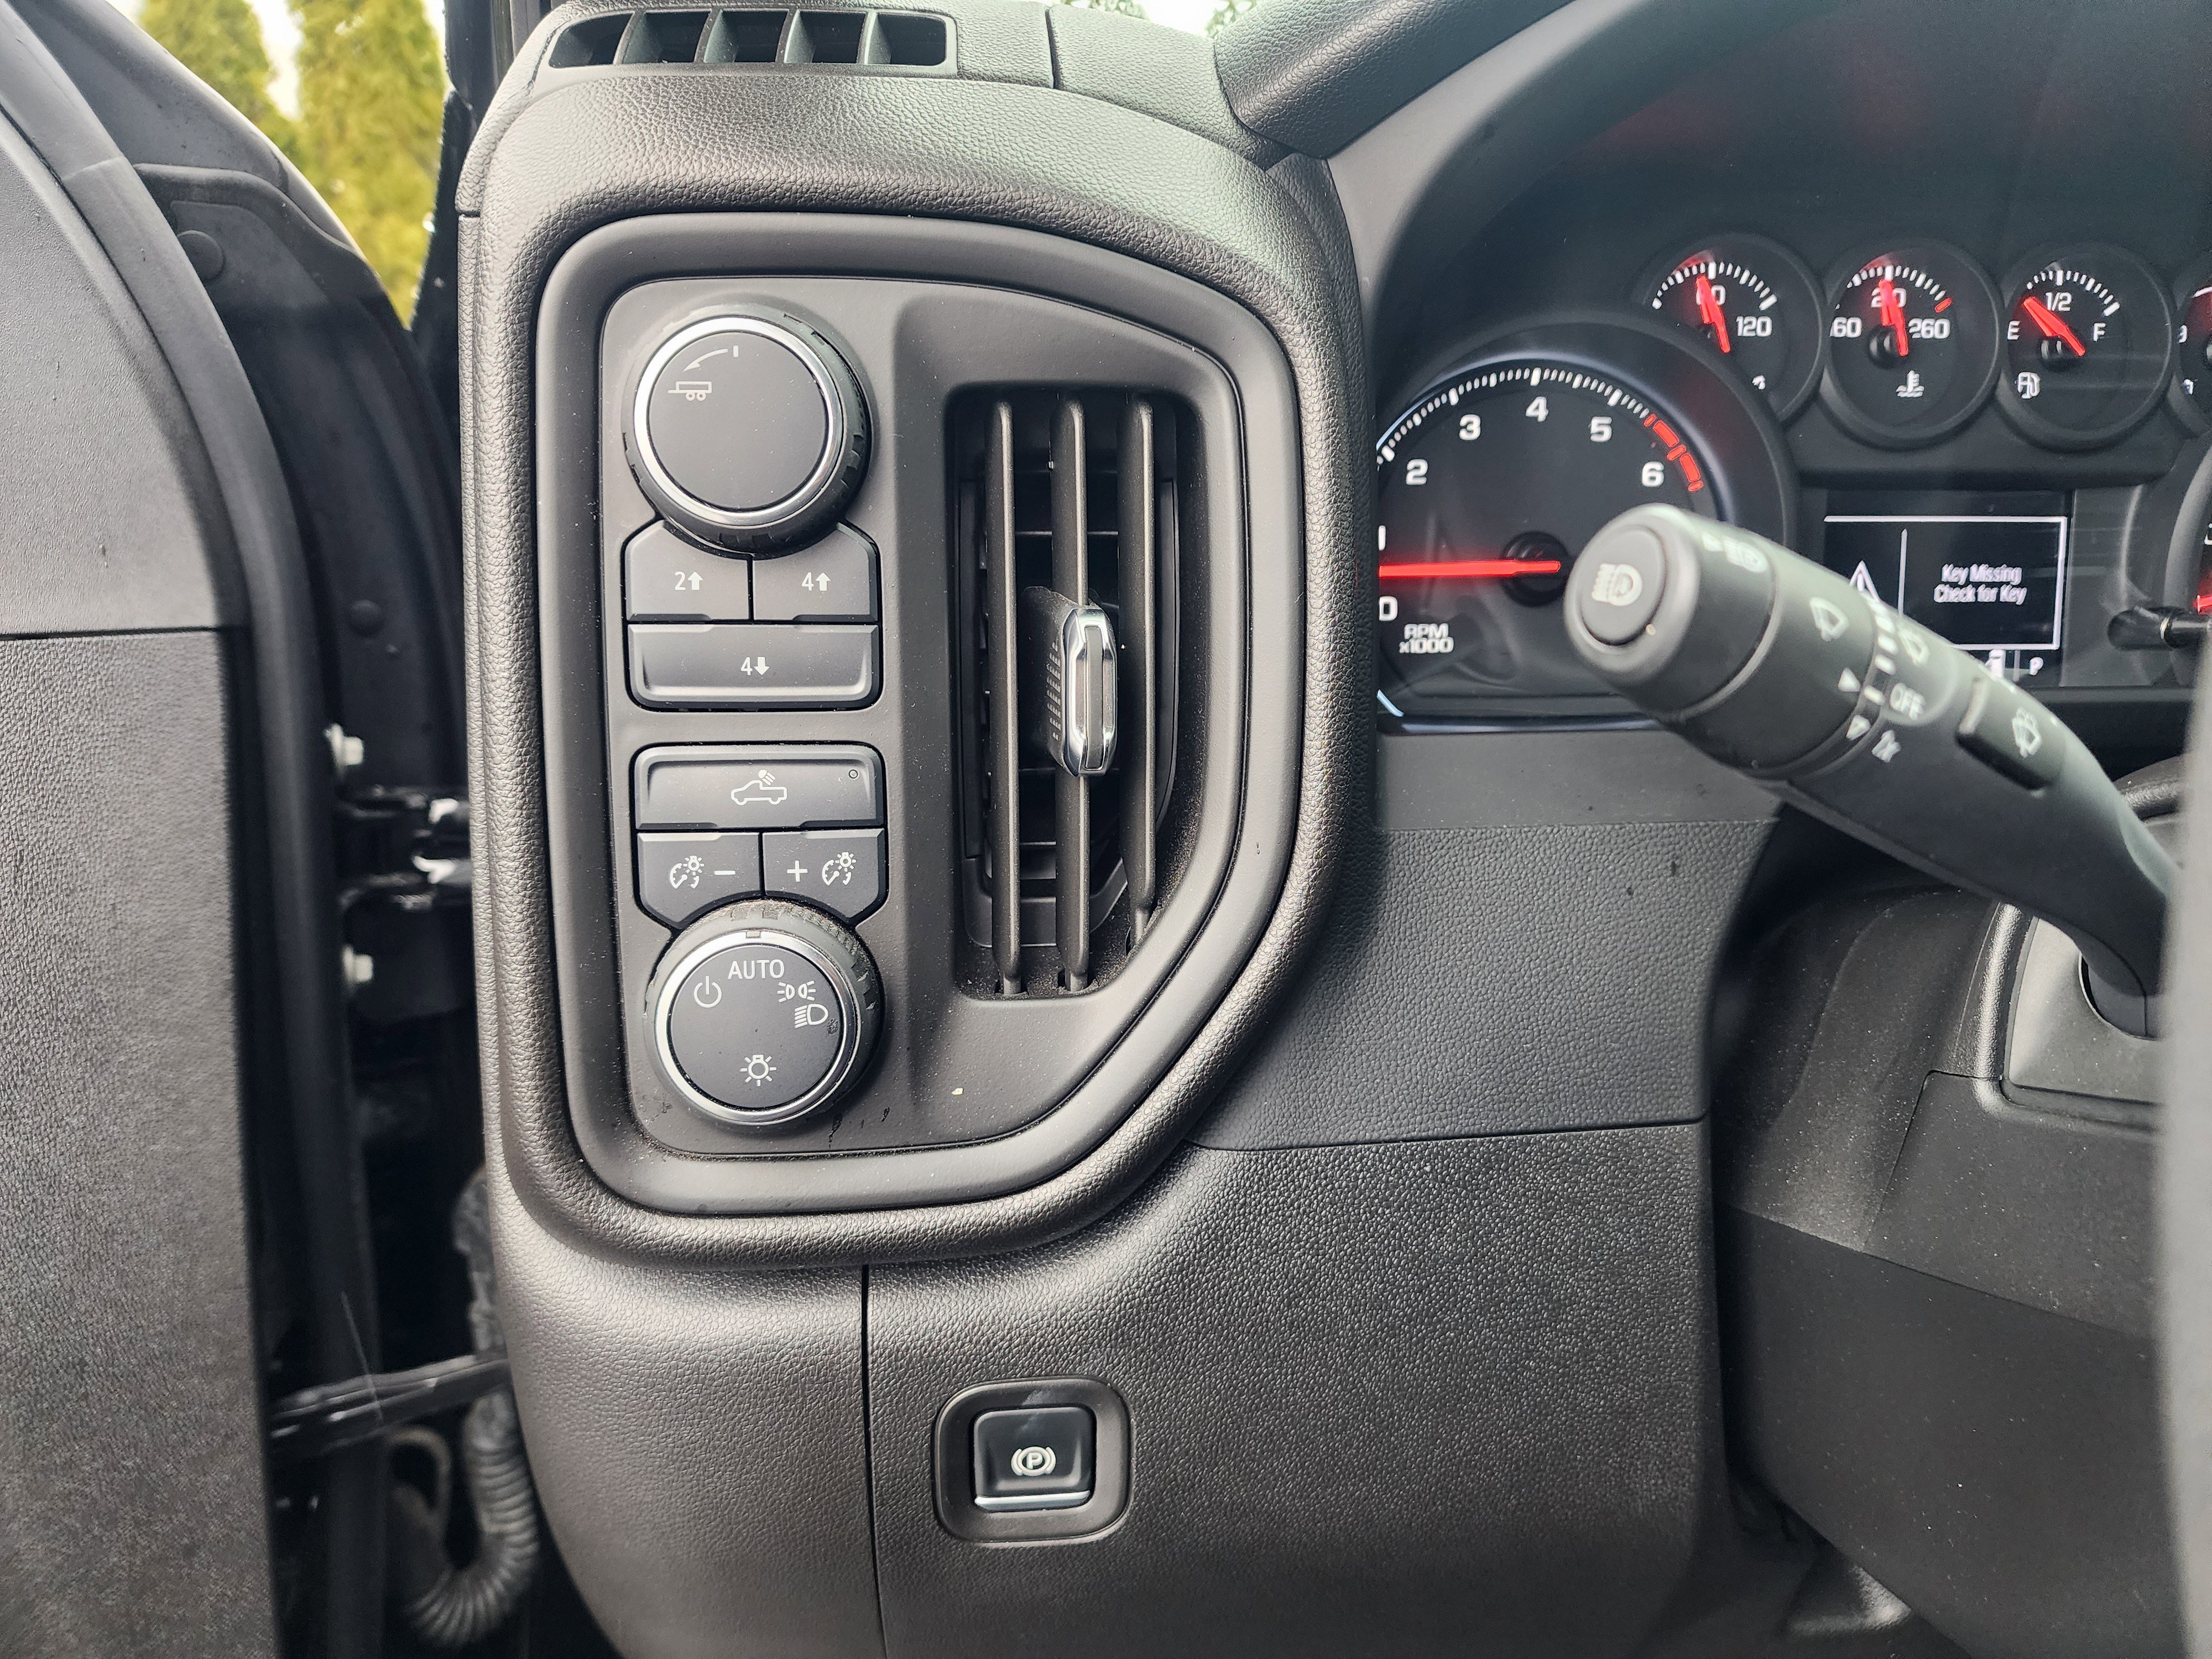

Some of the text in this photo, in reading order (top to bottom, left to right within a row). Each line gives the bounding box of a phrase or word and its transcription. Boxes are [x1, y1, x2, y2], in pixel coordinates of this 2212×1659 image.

[2046, 292, 2072, 311] 1/2
[1736, 316, 1772, 337] 120
[1908, 318, 1950, 339] 260
[2007, 320, 2020, 340] E
[2093, 322, 2106, 342] F
[1526, 397, 1548, 421] 4
[1460, 414, 1481, 440] 3
[1590, 416, 1613, 442] 5
[1406, 459, 1428, 485] 2
[1642, 462, 1663, 487] 6
[675, 572, 686, 591] 2
[802, 572, 814, 591] 4
[1942, 564, 2022, 585] Key Missing
[1934, 583, 1976, 603] Check
[2000, 583, 2027, 605] Key
[1404, 623, 1449, 639] RPM
[740, 657, 753, 675] 4
[1889, 682, 1926, 719] OFF
[728, 959, 785, 980] AUTO
